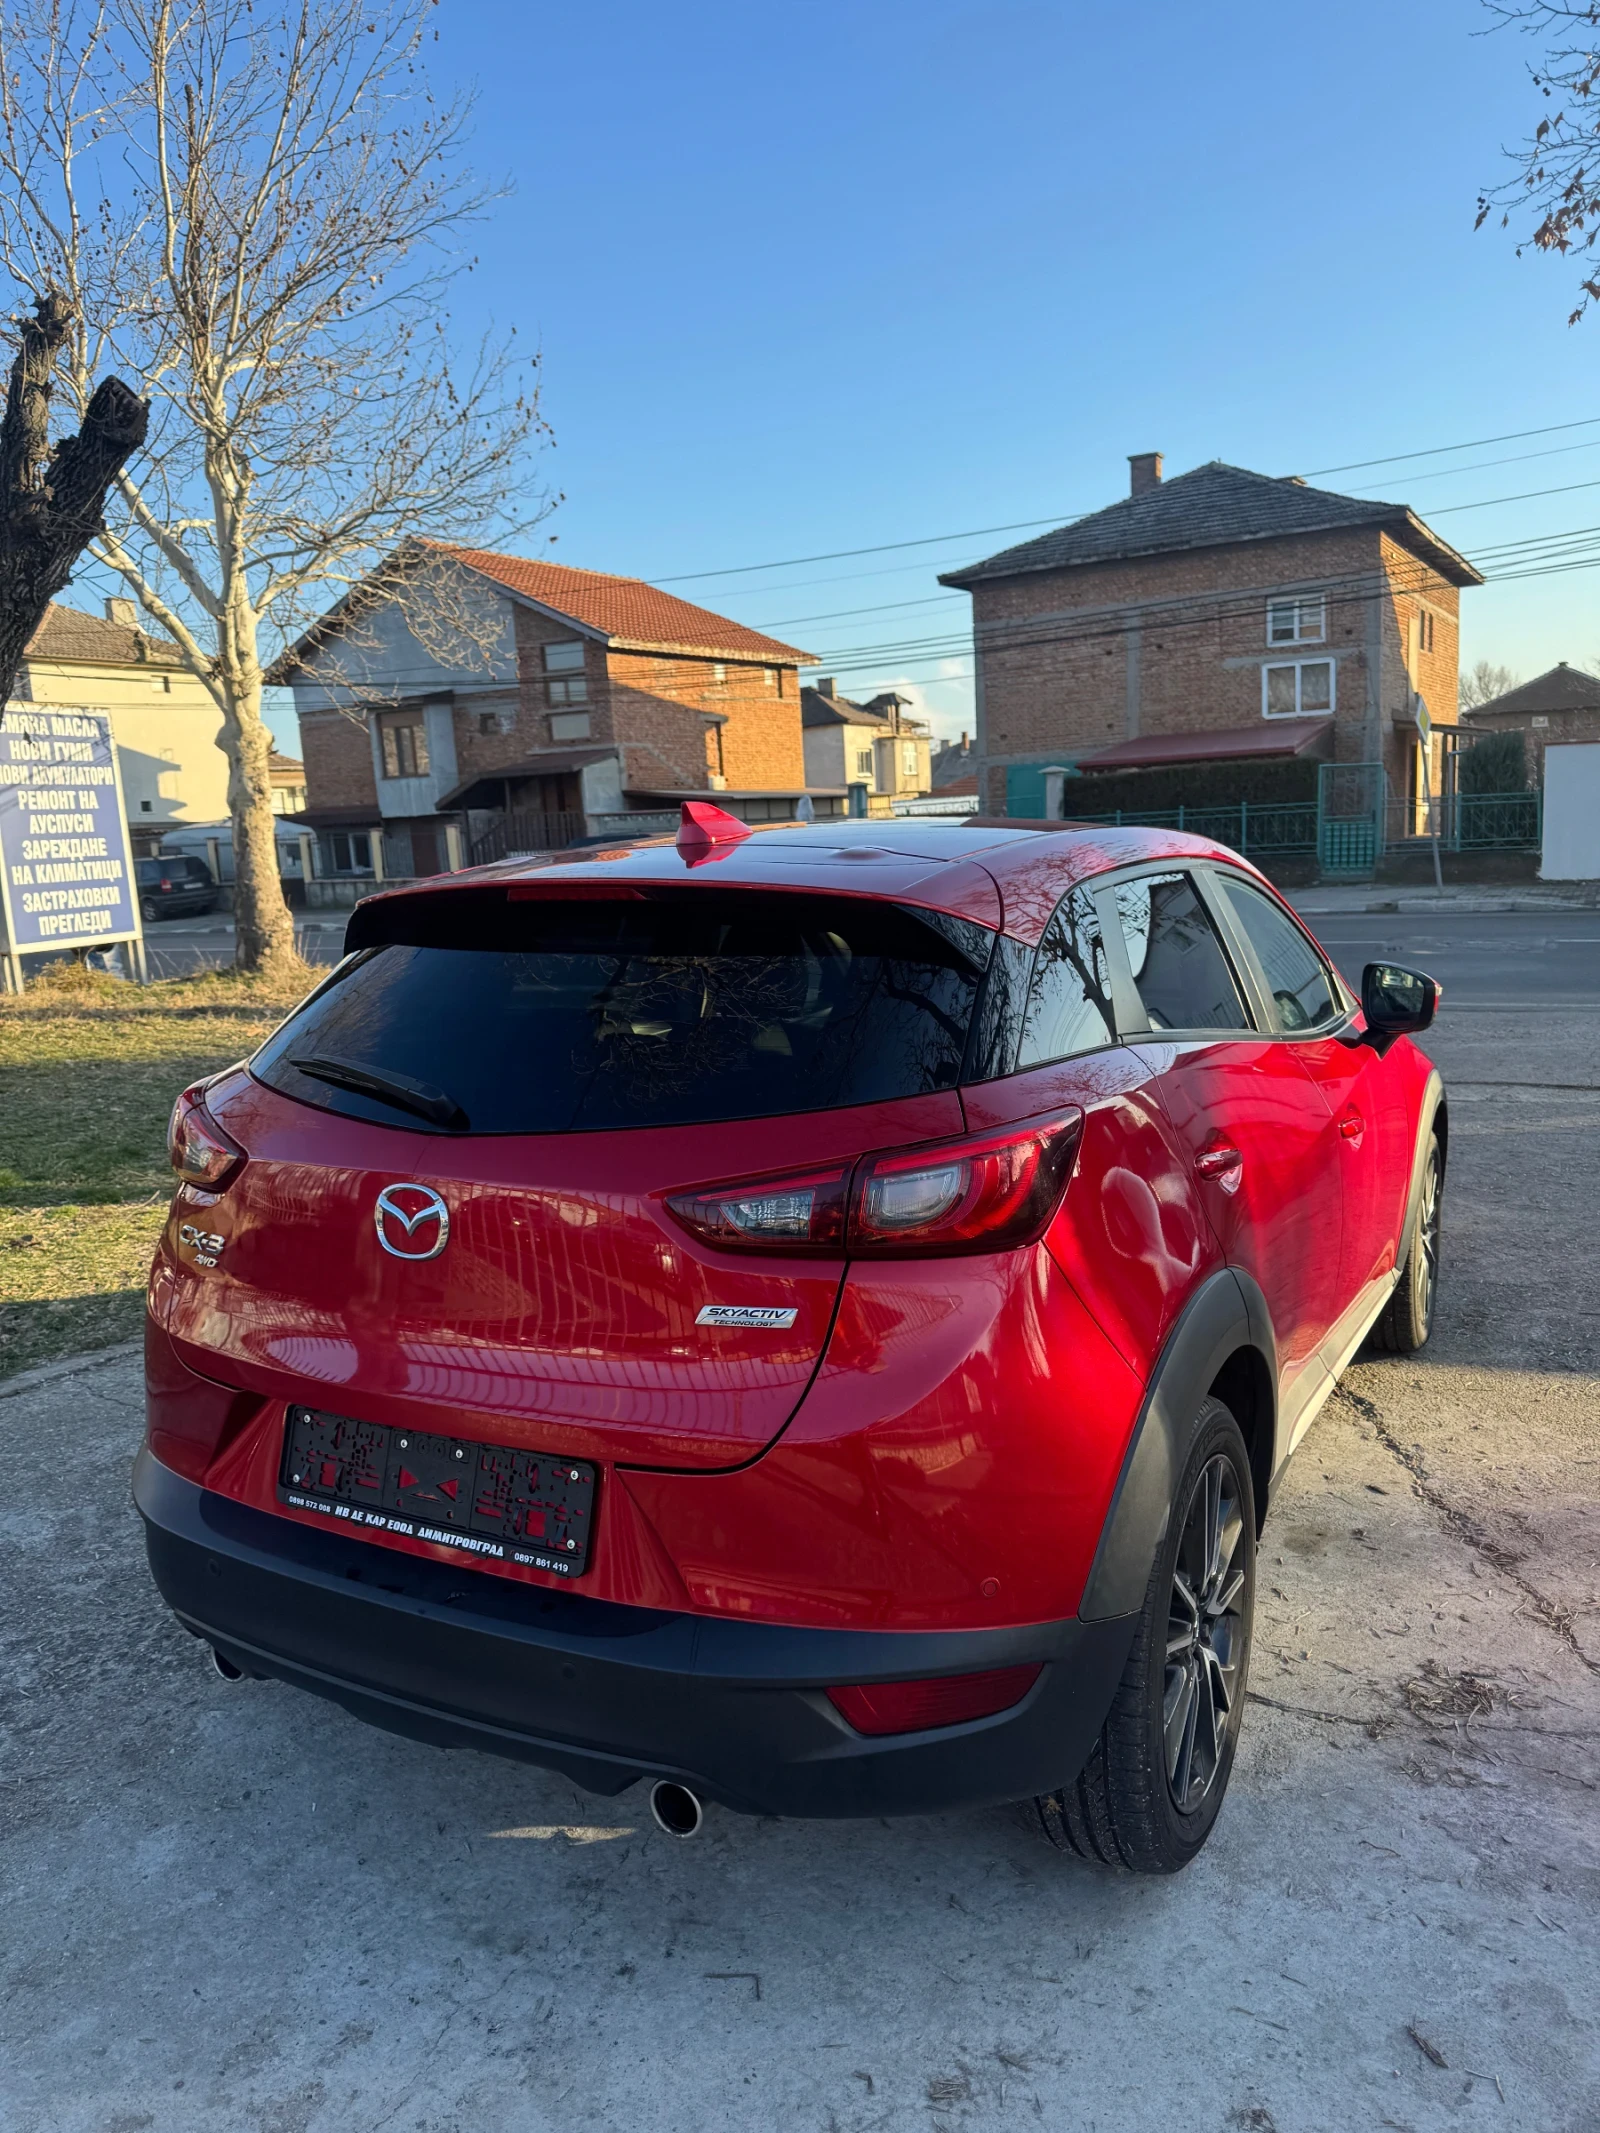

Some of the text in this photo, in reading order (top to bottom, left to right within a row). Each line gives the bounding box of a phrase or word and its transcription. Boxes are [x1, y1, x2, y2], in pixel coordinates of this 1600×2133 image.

[51, 716, 100, 738] МАСЛА
[9, 740, 94, 762] НОВИ ГУМИ
[32, 765, 114, 786] АКУМУЛАТОРИ
[17, 790, 100, 811] РЕМОНТ НА
[29, 813, 95, 835] АУСПУСИ
[22, 837, 108, 862] ЗАРЕЖДАНЕ
[11, 859, 123, 886] НА КЛИМАТИЦИ
[22, 886, 121, 913] ЗАСТРАХОВКИ
[38, 910, 112, 936] ПРЕГЛЕДИ
[179, 1224, 225, 1255] CX-3
[193, 1254, 218, 1268] AWD
[707, 1307, 788, 1319] SKYACTIV
[713, 1319, 776, 1327] TECHNOLOGY
[305, 1500, 318, 1509] 572
[318, 1503, 331, 1513] 008
[334, 1505, 350, 1517] ИВ
[351, 1510, 365, 1521] ДЕ
[365, 1513, 386, 1527] КАР
[387, 1520, 414, 1535] ЕООД
[417, 1527, 504, 1557] ДИМИТРОВГРАД
[514, 1552, 533, 1564] 0897
[535, 1556, 551, 1569] 861
[552, 1560, 569, 1573] 419
